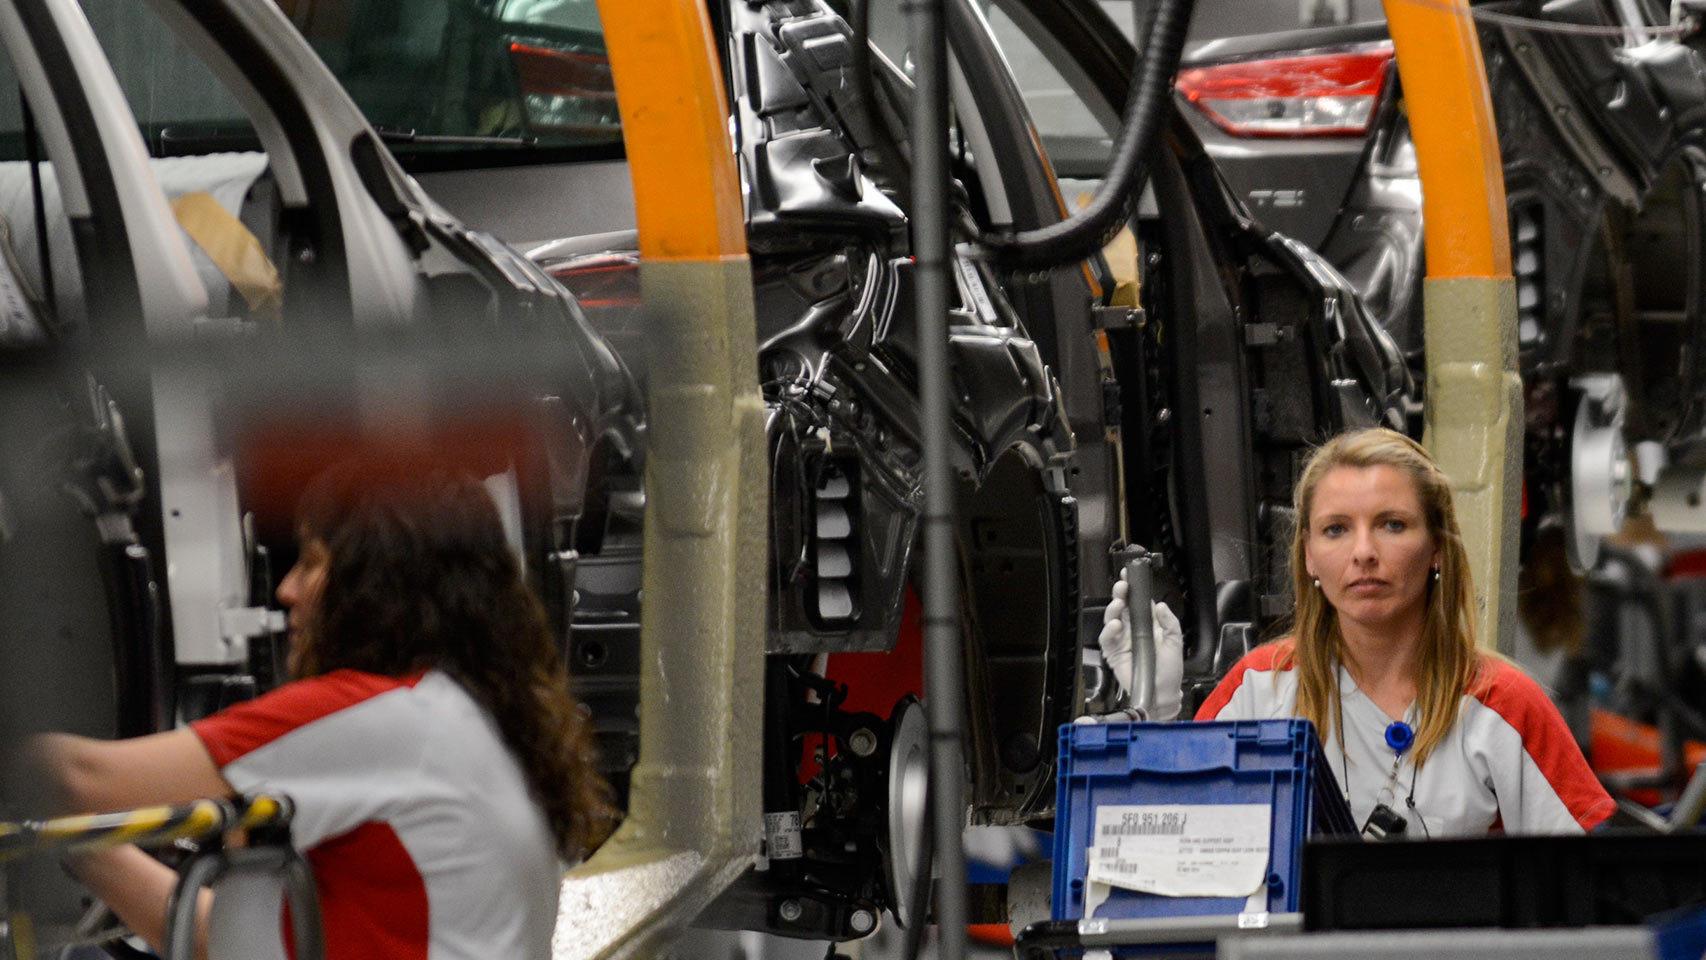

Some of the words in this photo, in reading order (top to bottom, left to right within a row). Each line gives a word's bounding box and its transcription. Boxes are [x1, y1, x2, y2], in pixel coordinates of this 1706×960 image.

[1249, 190, 1304, 206] TSI
[1142, 812, 1158, 826] 951
[1162, 812, 1178, 825] 206
